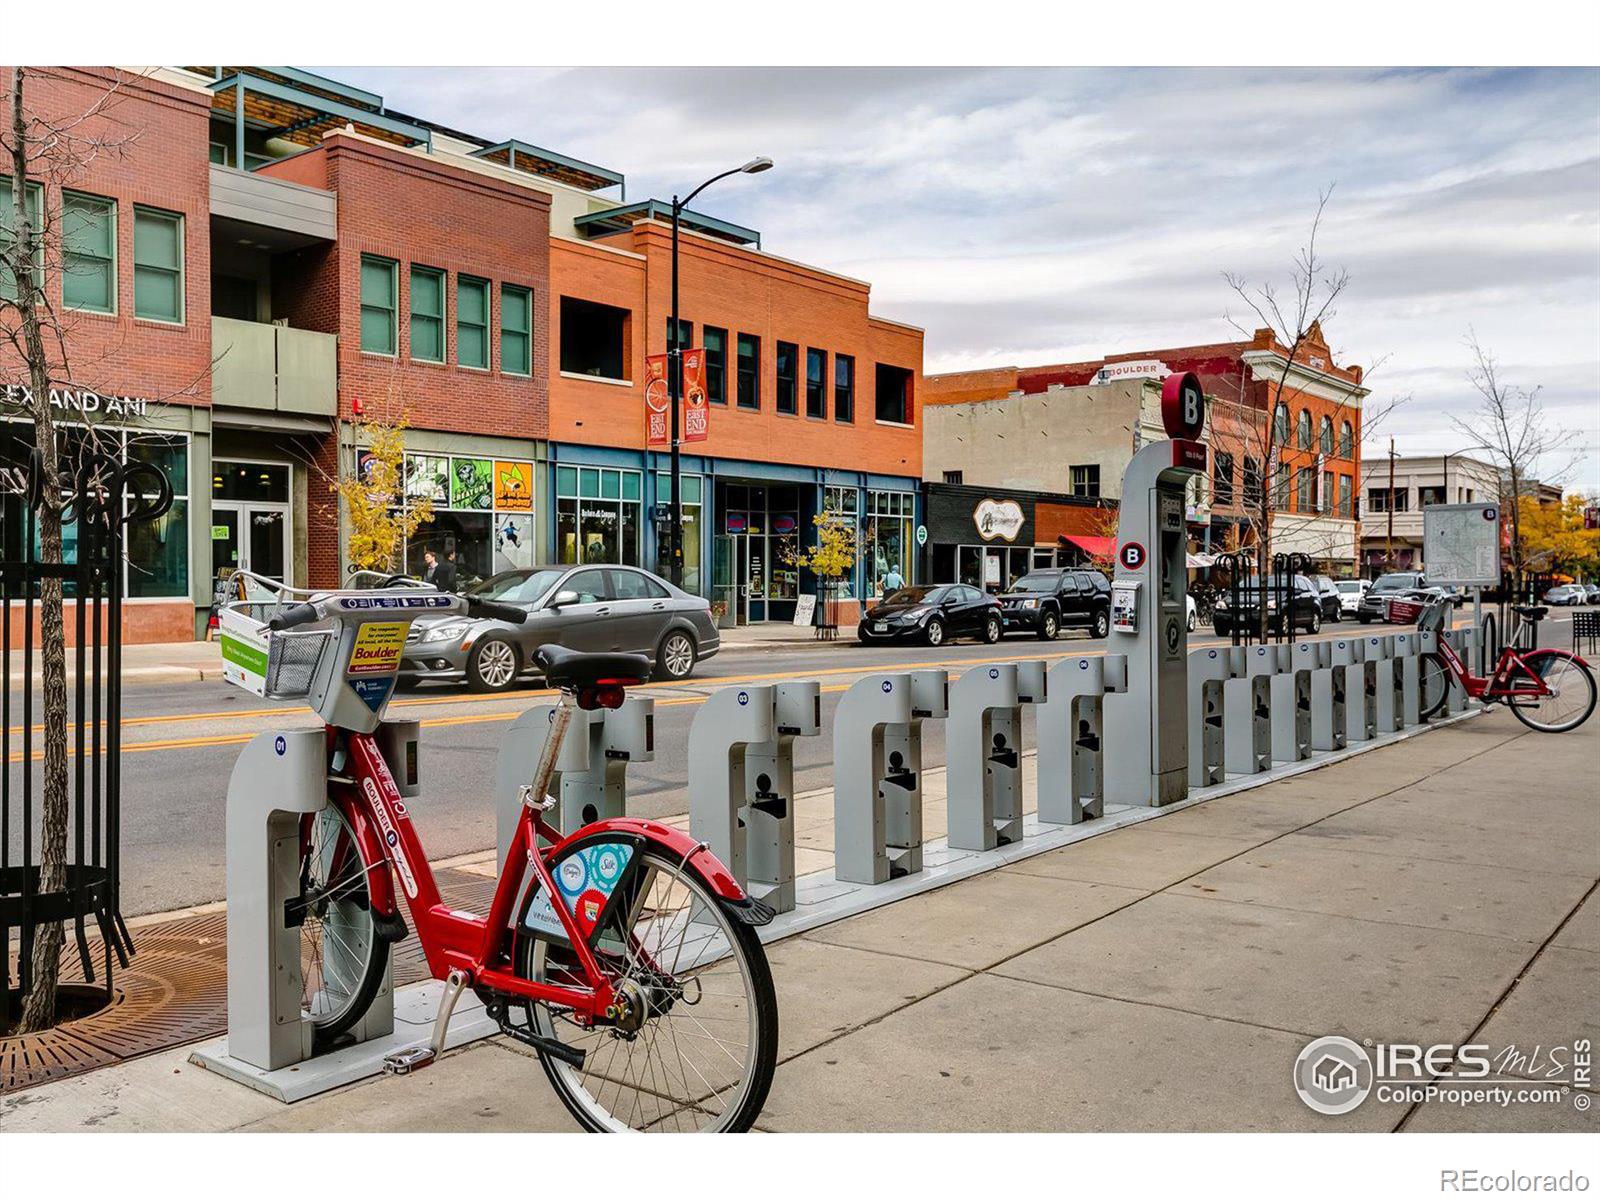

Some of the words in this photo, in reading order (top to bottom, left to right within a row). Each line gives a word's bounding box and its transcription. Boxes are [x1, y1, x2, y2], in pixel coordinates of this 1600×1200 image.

[1109, 365, 1157, 376] BOULDER
[49, 388, 100, 412] AND
[105, 395, 146, 416] ANI
[1184, 388, 1199, 425] B
[686, 409, 706, 420] EAST
[650, 423, 665, 435] END
[686, 419, 707, 432] END
[1487, 510, 1495, 519] B
[1127, 548, 1139, 563] B
[355, 647, 399, 659] Boulder
[276, 740, 285, 751] 01
[365, 782, 391, 831] BOULDER
